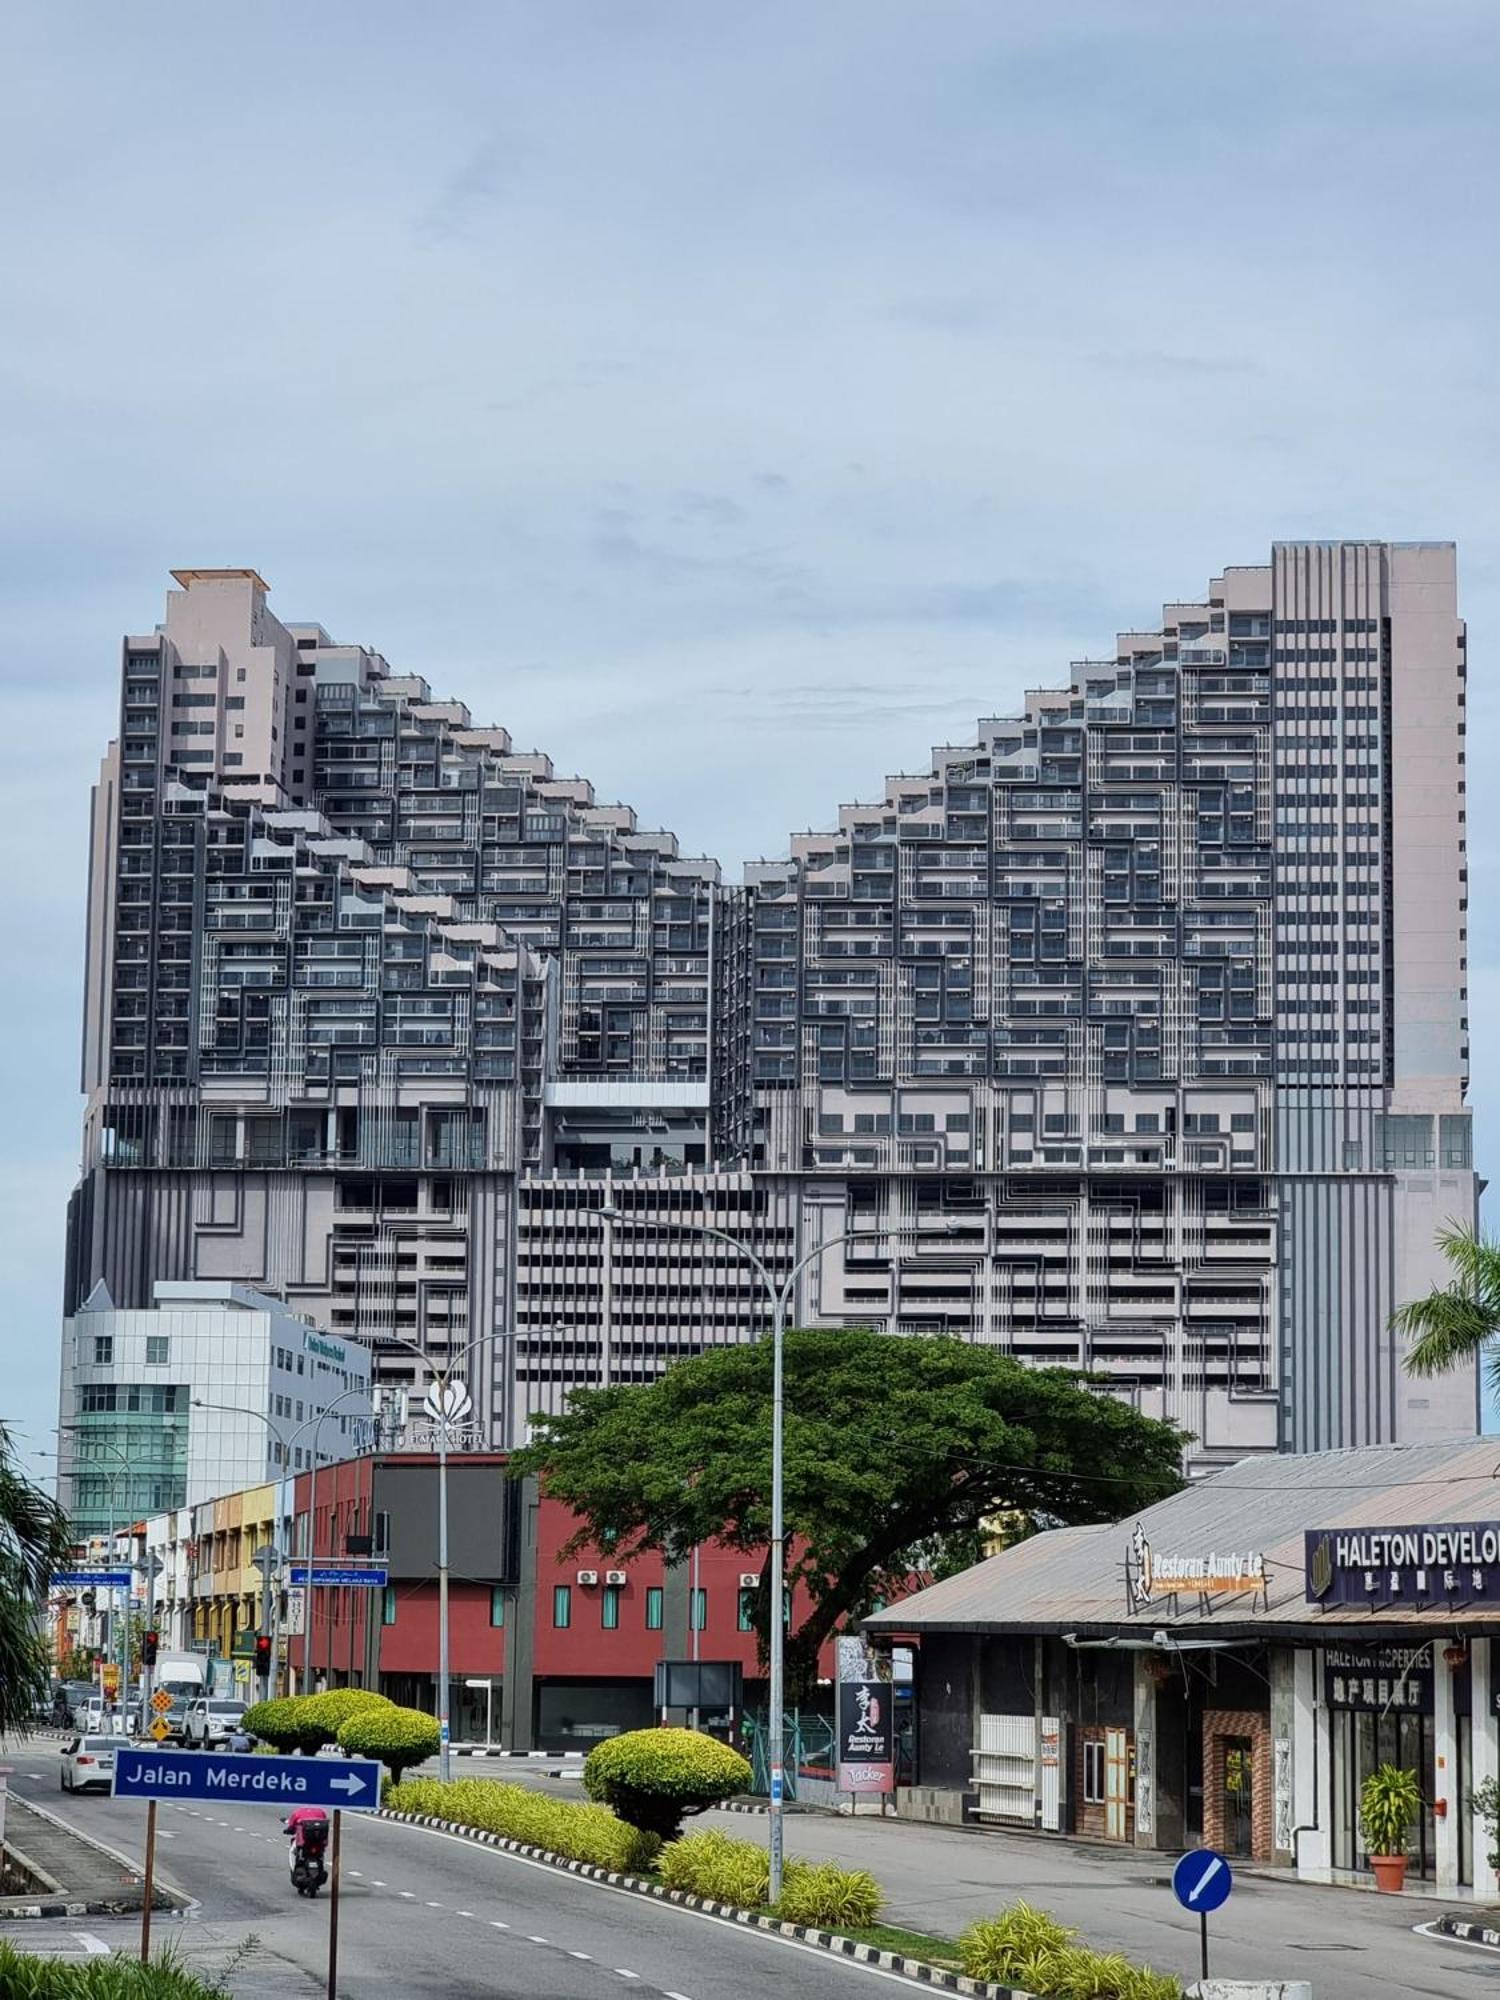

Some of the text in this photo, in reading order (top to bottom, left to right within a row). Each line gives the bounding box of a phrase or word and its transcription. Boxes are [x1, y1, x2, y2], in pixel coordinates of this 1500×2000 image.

[1336, 1530, 1500, 1567] HALETON DEVELO
[1153, 1551, 1264, 1582] Restoran Aunty Le
[1372, 1648, 1431, 1669] ROPERTIES
[848, 1735, 885, 1743] Restoran
[848, 1743, 873, 1752] Aunty
[126, 1764, 307, 1791] Jalan Merdeka
